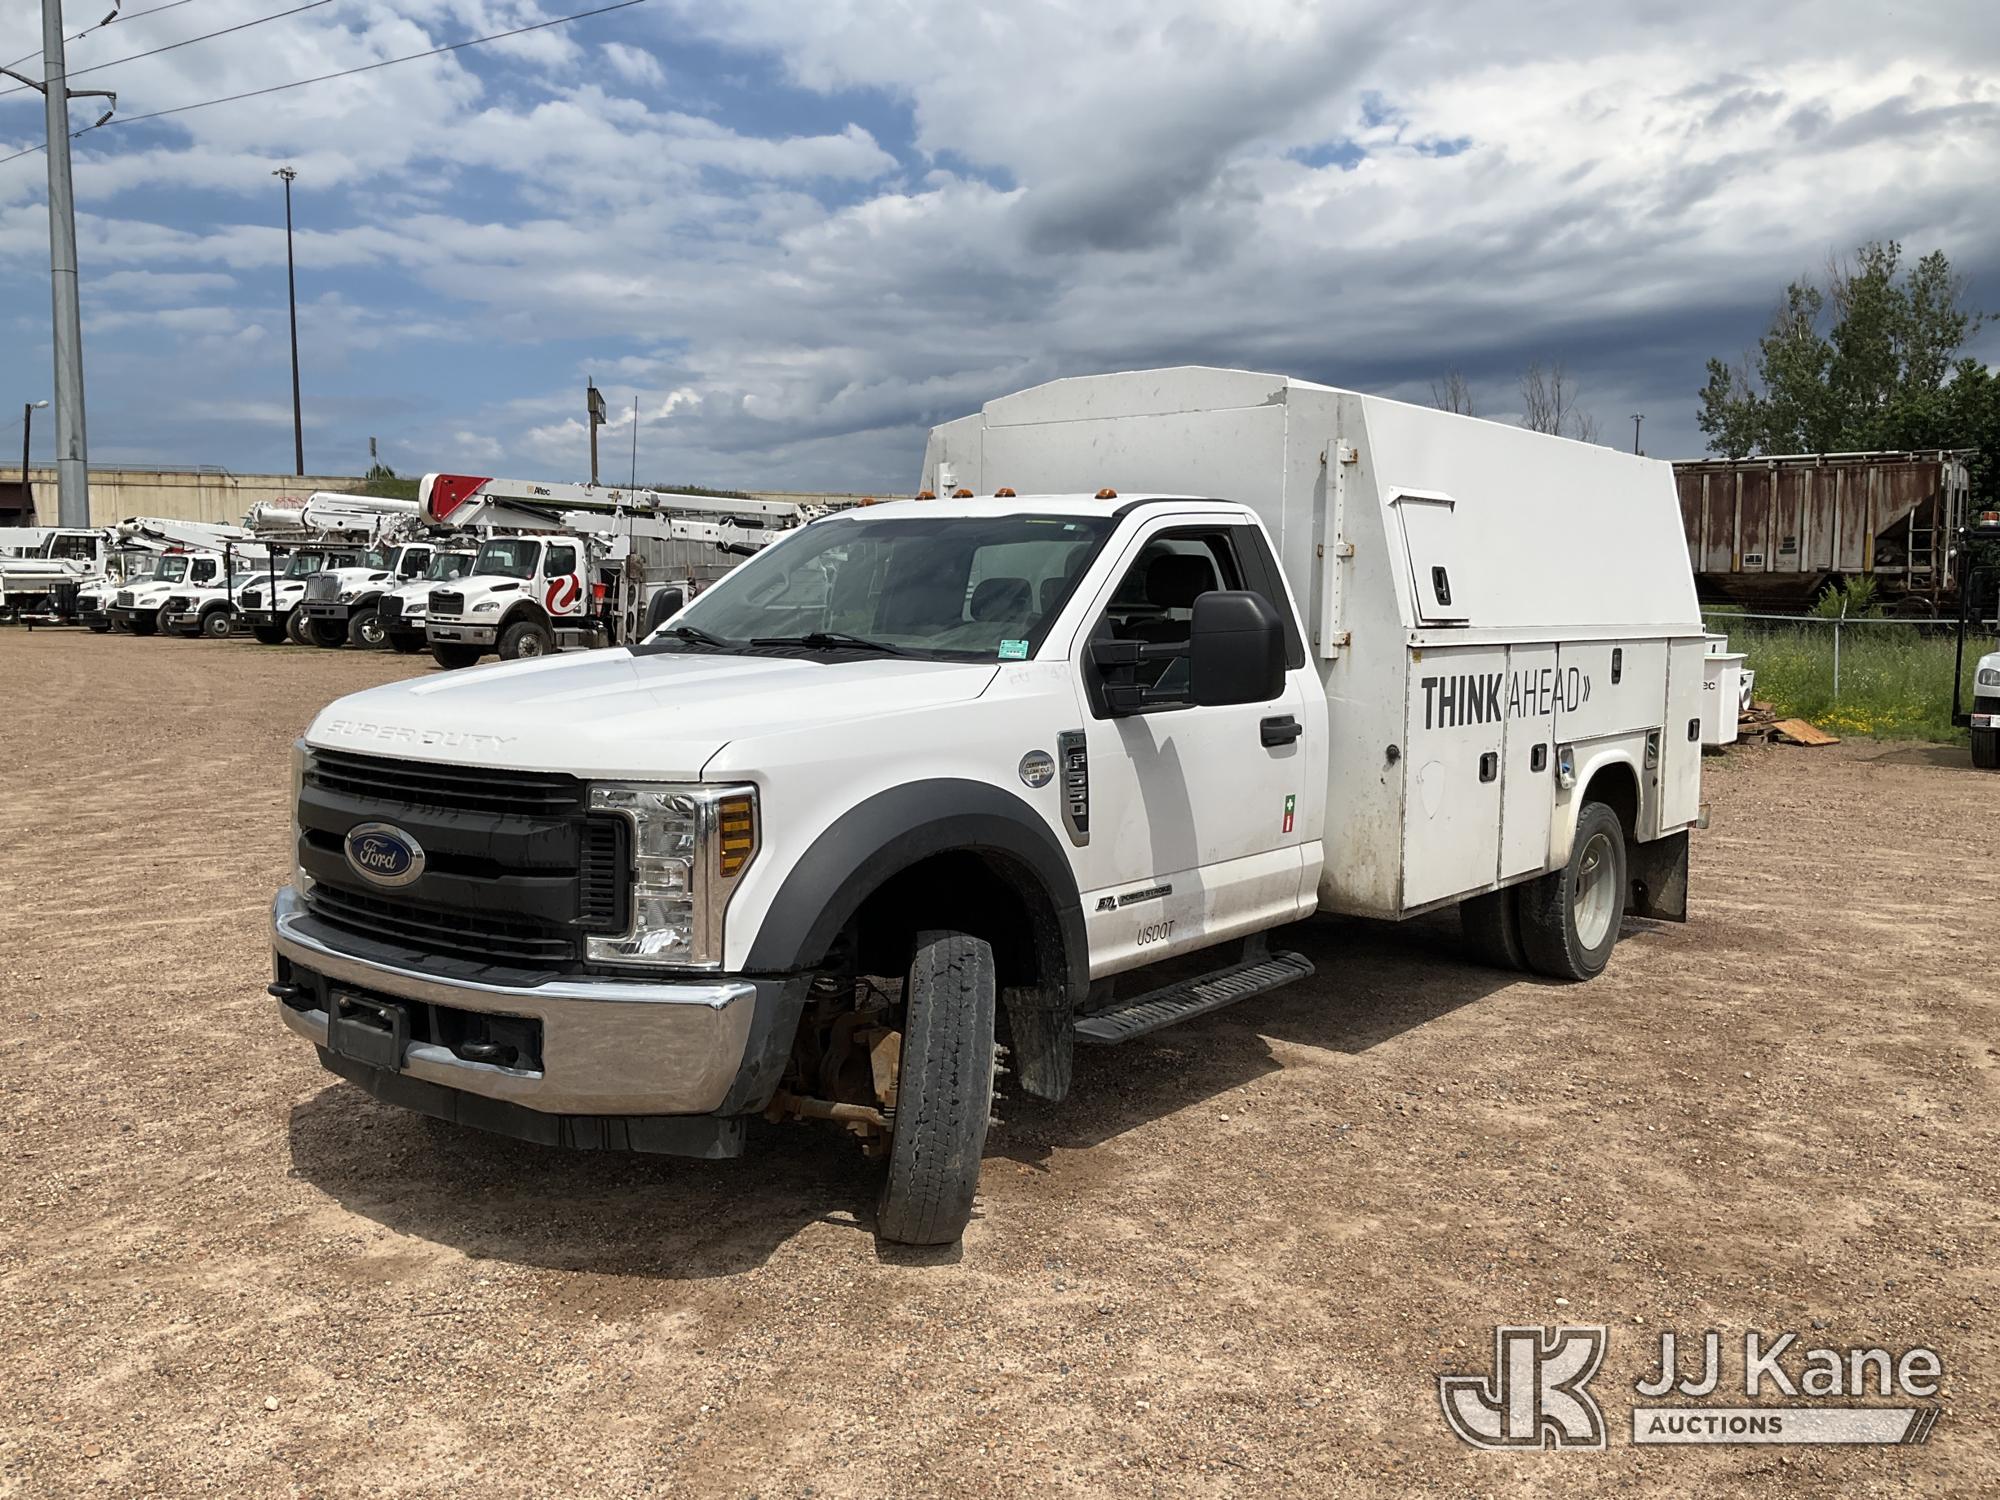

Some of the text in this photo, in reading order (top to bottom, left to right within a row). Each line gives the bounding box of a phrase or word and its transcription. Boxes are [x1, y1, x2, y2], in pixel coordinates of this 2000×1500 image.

[534, 486, 551, 496] Altec
[1421, 667, 1580, 730] THINK AHEAD
[327, 719, 518, 750] SUPER DUTY
[360, 838, 397, 871] Ford
[1120, 891, 1145, 902] POWER
[1145, 885, 1171, 897] STROKE
[1137, 920, 1175, 946] USDOT
